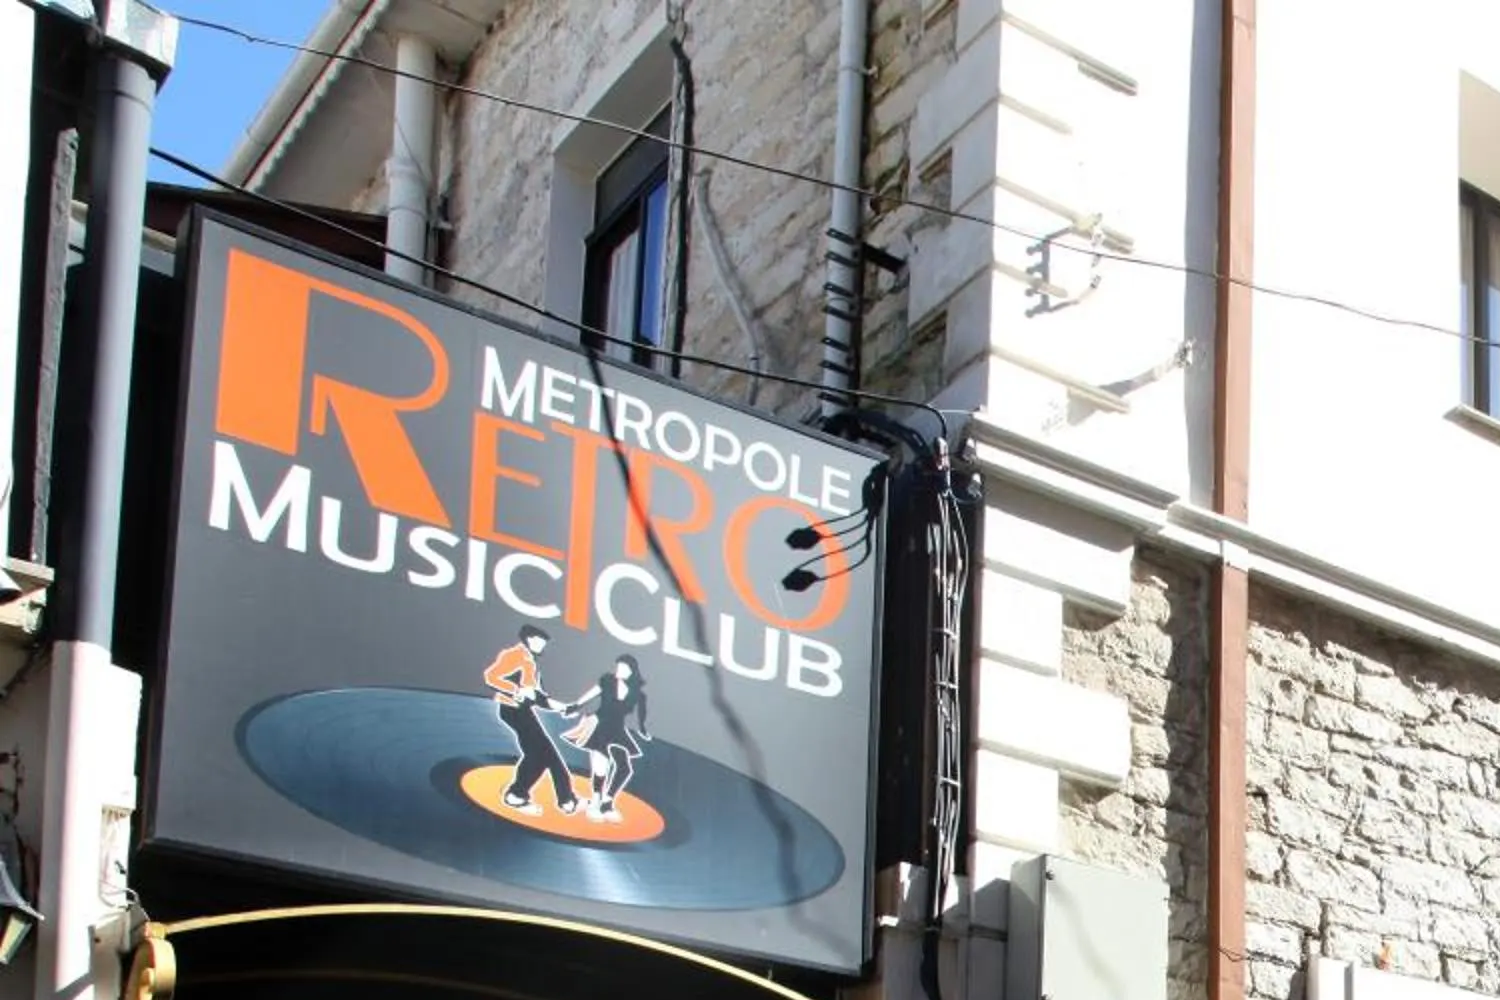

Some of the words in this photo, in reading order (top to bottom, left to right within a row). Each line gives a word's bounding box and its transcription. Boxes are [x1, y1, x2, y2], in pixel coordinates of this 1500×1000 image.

[215, 247, 845, 631] RETRO
[480, 345, 852, 515] METROPOLE
[208, 440, 562, 620] MUSIC
[596, 562, 843, 699] CLUB
